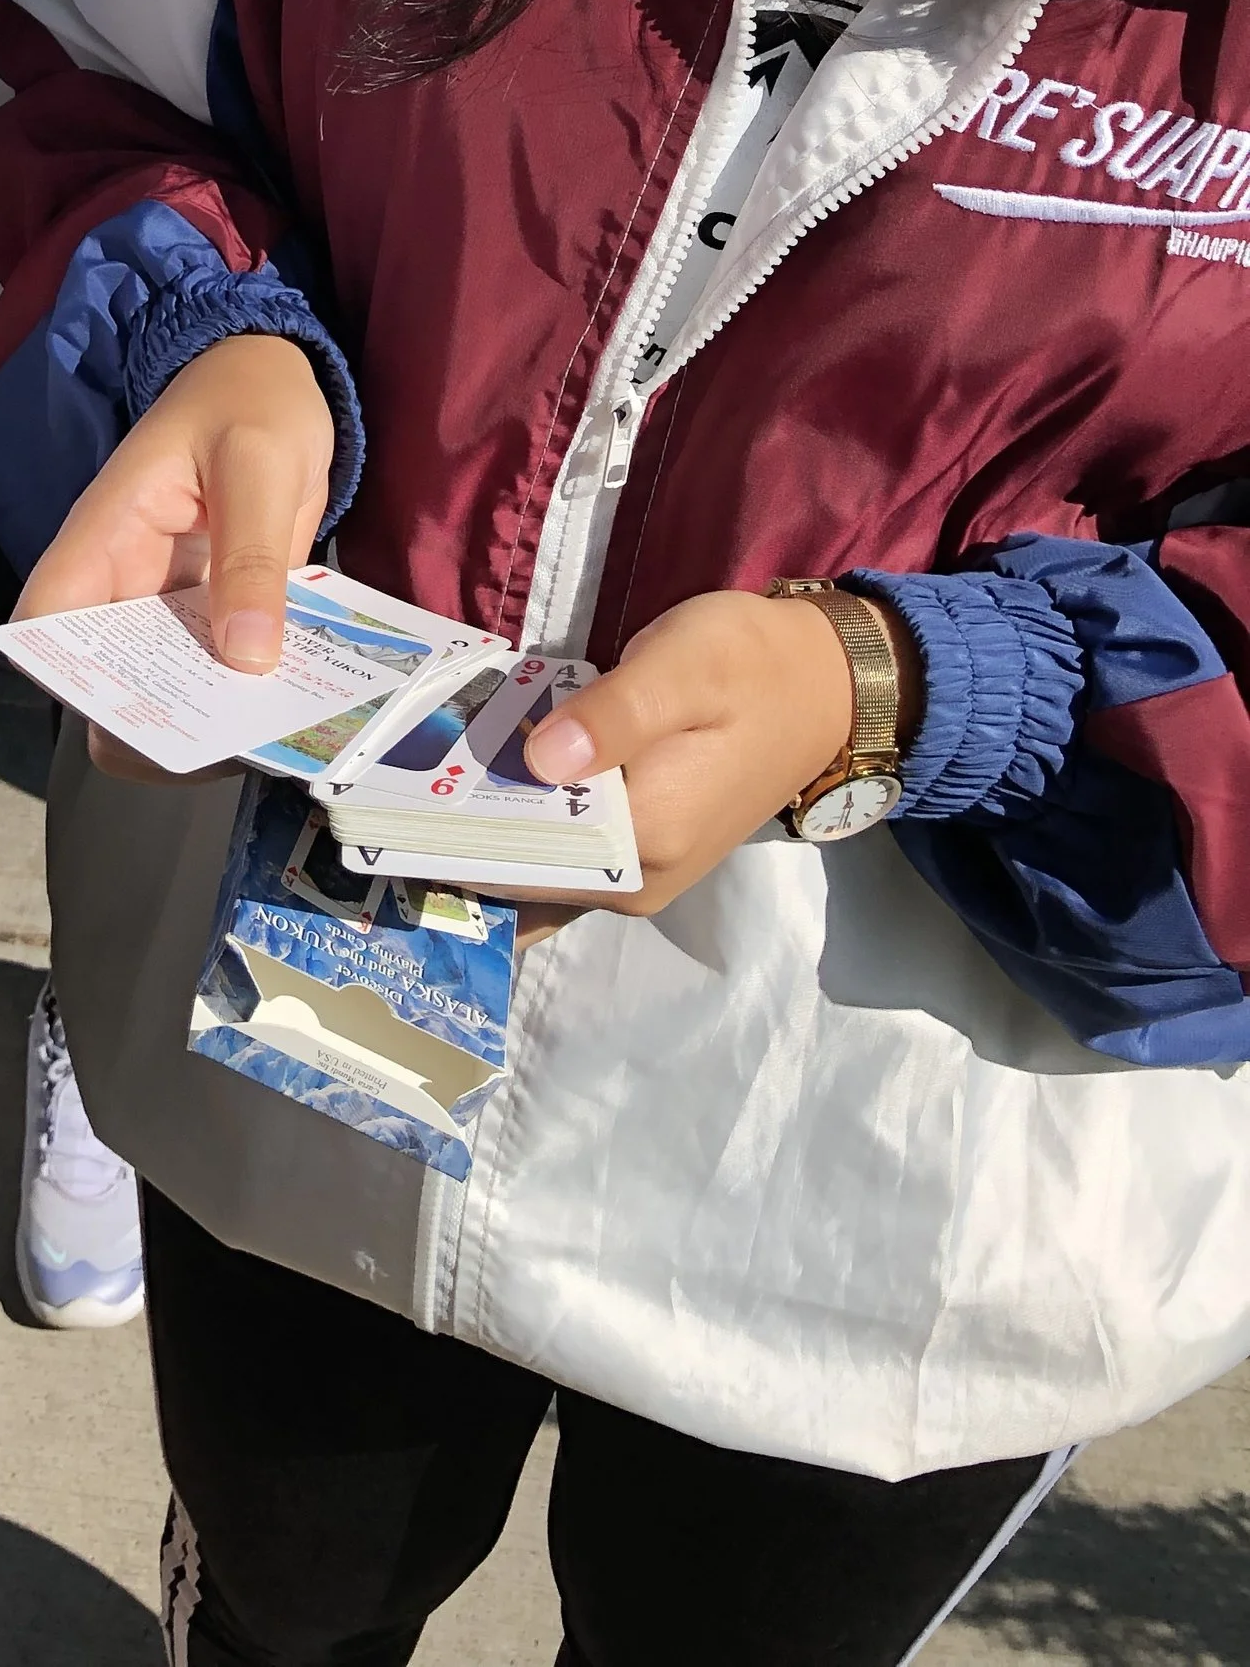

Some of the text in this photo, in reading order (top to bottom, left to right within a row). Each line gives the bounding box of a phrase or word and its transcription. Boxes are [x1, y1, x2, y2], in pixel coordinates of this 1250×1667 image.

[285, 630, 335, 654] COVER
[291, 642, 322, 657] THE
[323, 656, 375, 680] YUKON
[521, 660, 545, 675] 9
[556, 664, 578, 679] 4
[504, 796, 546, 805] RANGE
[566, 798, 590, 816] 4
[254, 905, 488, 1027] ALASKA and the YUKON
[325, 922, 425, 979] Playing Cards
[334, 963, 404, 1006] Discover
[316, 1049, 388, 1091] Printed in USA
